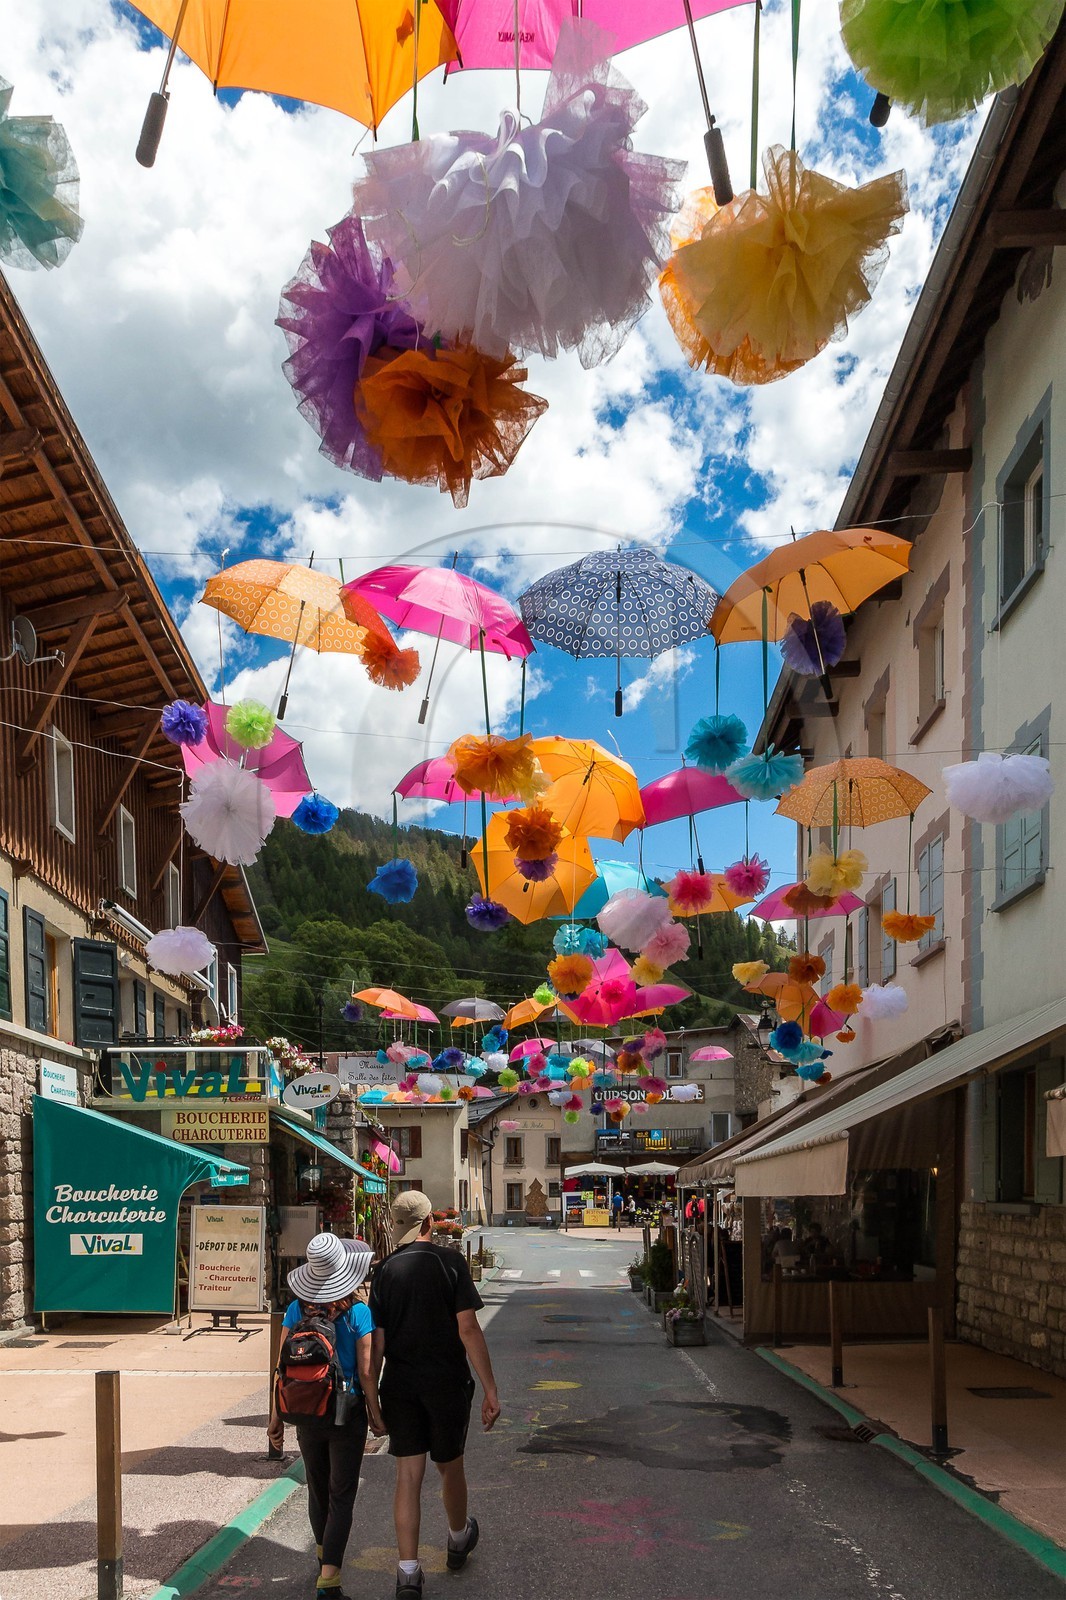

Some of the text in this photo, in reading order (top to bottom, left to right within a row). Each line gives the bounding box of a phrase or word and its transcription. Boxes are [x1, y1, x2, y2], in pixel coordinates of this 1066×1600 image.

[359, 1060, 385, 1070] Mairie
[347, 1071, 397, 1083] Salle des fêtes
[176, 1111, 267, 1125] BOUCHERIE
[172, 1128, 267, 1141] CHARCUTERIE
[54, 1184, 158, 1202] Boucherie
[45, 1205, 167, 1223] Charcuterie
[227, 1242, 238, 1252] DE
[240, 1242, 259, 1252] PAIN
[199, 1263, 241, 1272] Boucherie
[209, 1274, 257, 1283] Charcuterie
[198, 1283, 232, 1292] Traiteur
